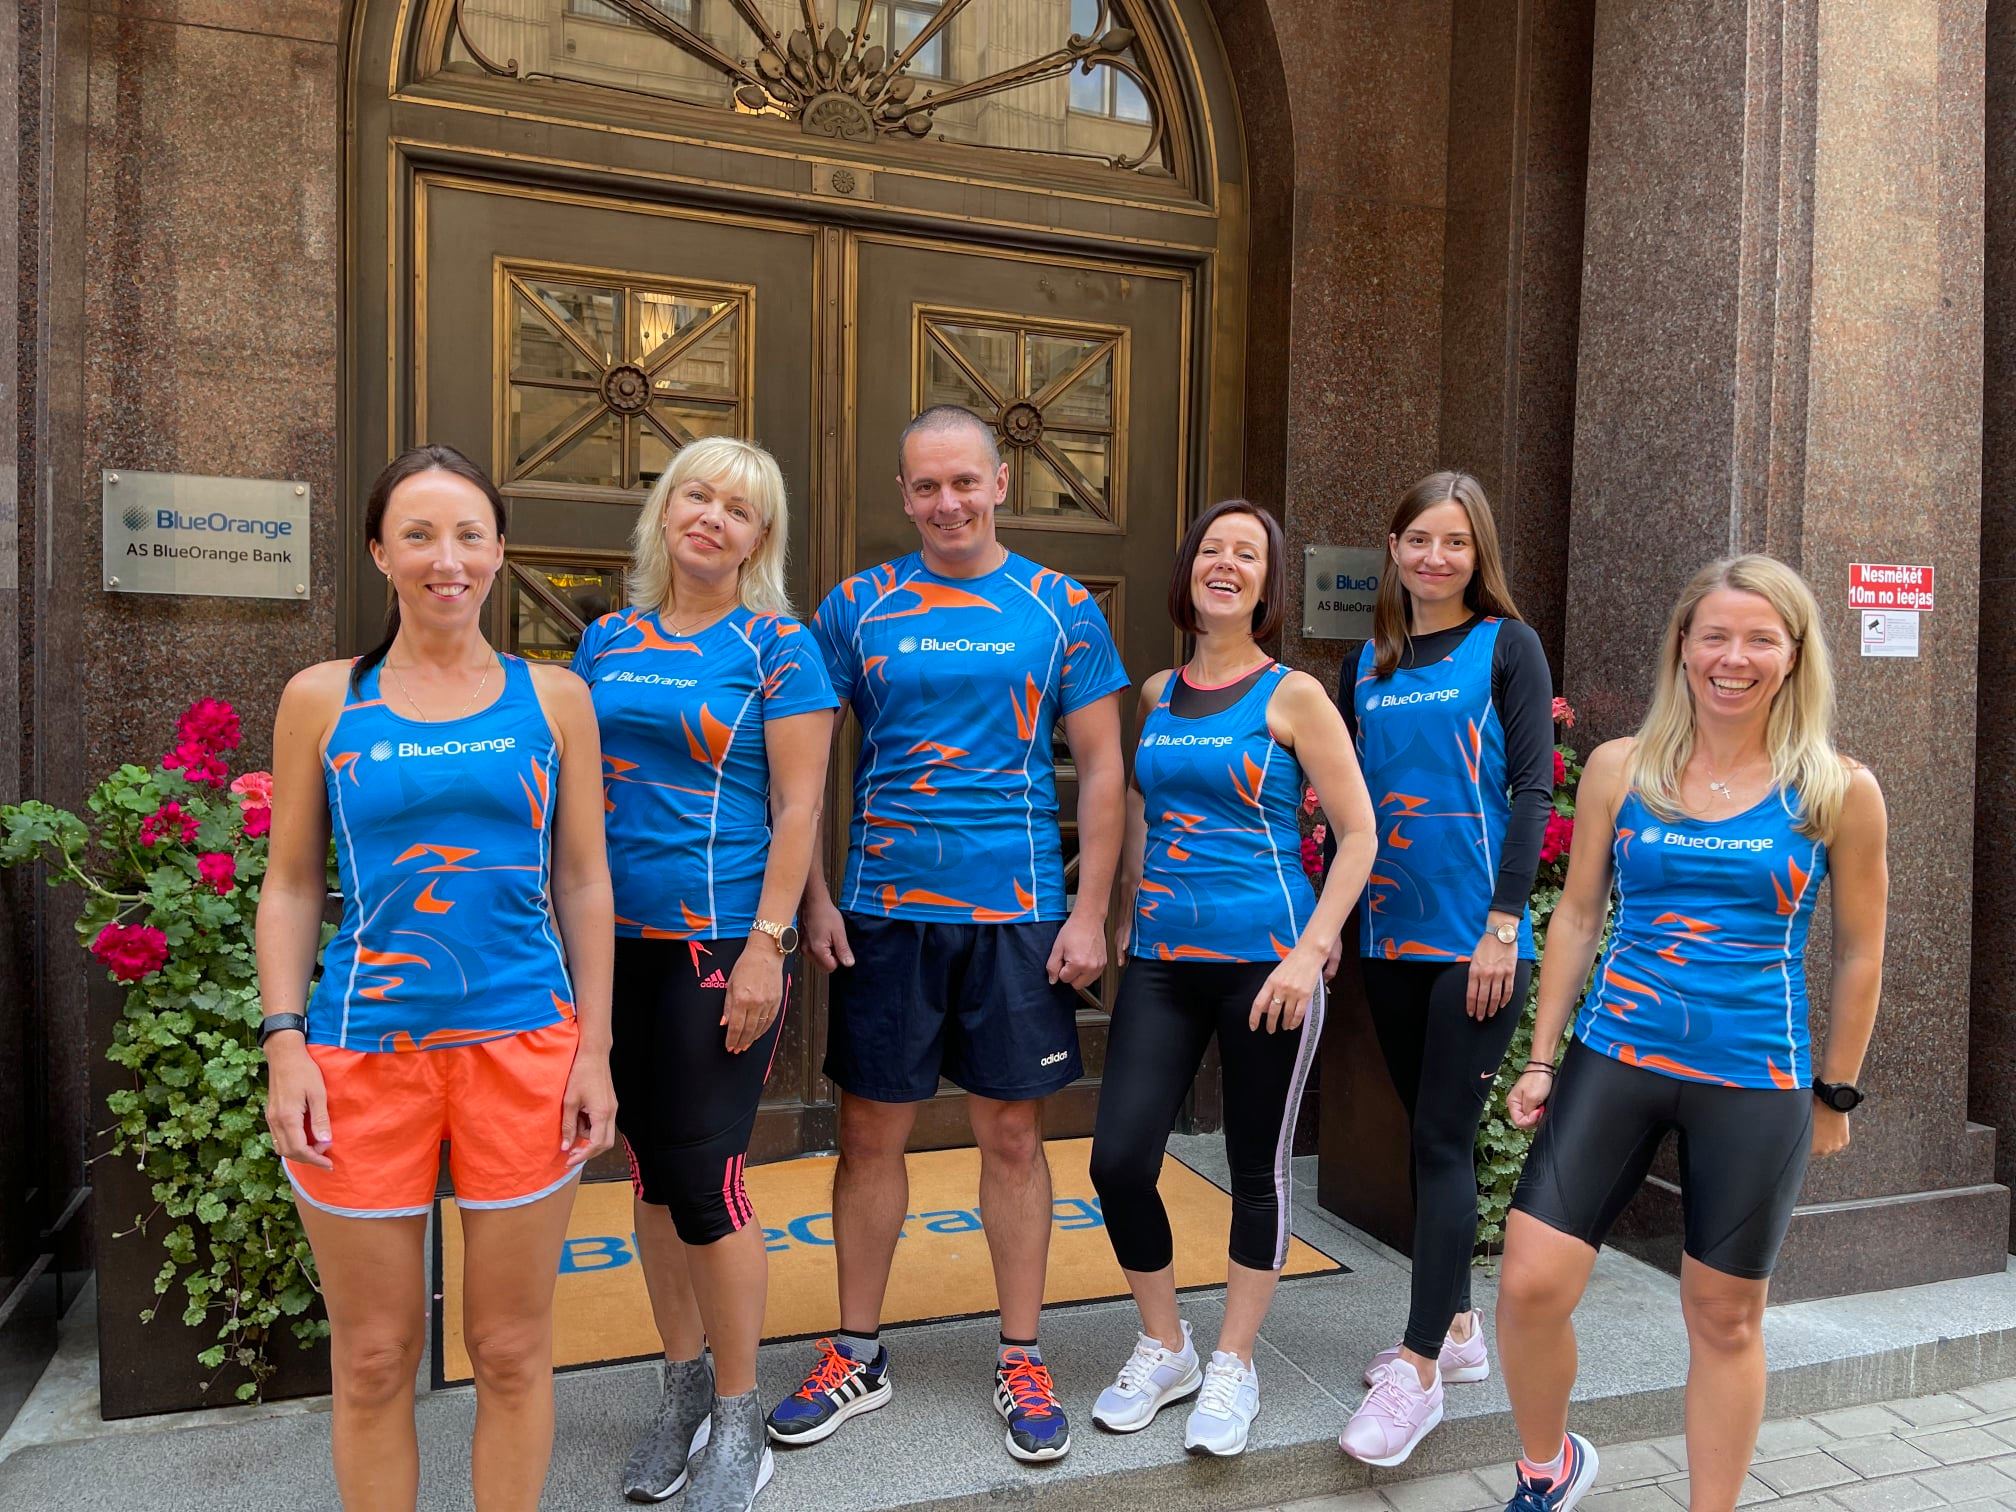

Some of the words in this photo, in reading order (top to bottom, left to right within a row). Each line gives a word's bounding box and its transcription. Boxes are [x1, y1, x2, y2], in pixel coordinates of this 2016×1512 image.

[156, 509, 292, 539] BlueOrange
[126, 543, 148, 557] AS
[153, 544, 248, 563] BlueOrange
[253, 549, 292, 563] Bank
[1336, 574, 1379, 591] BlueO
[1849, 586, 1875, 604] 10m
[1878, 591, 1894, 604] no
[1896, 587, 1933, 609] ieejas
[1317, 601, 1331, 611] AS
[1333, 602, 1376, 613] BlueOra
[920, 638, 1016, 655] BlueOrange
[617, 671, 698, 688] BlueOrange
[1381, 688, 1460, 707] BlueOrange
[398, 736, 516, 757] BlueOrange
[1155, 734, 1233, 747] BlueOrange
[1663, 832, 1774, 852] BlueOrange
[1040, 1050, 1068, 1067] adidas
